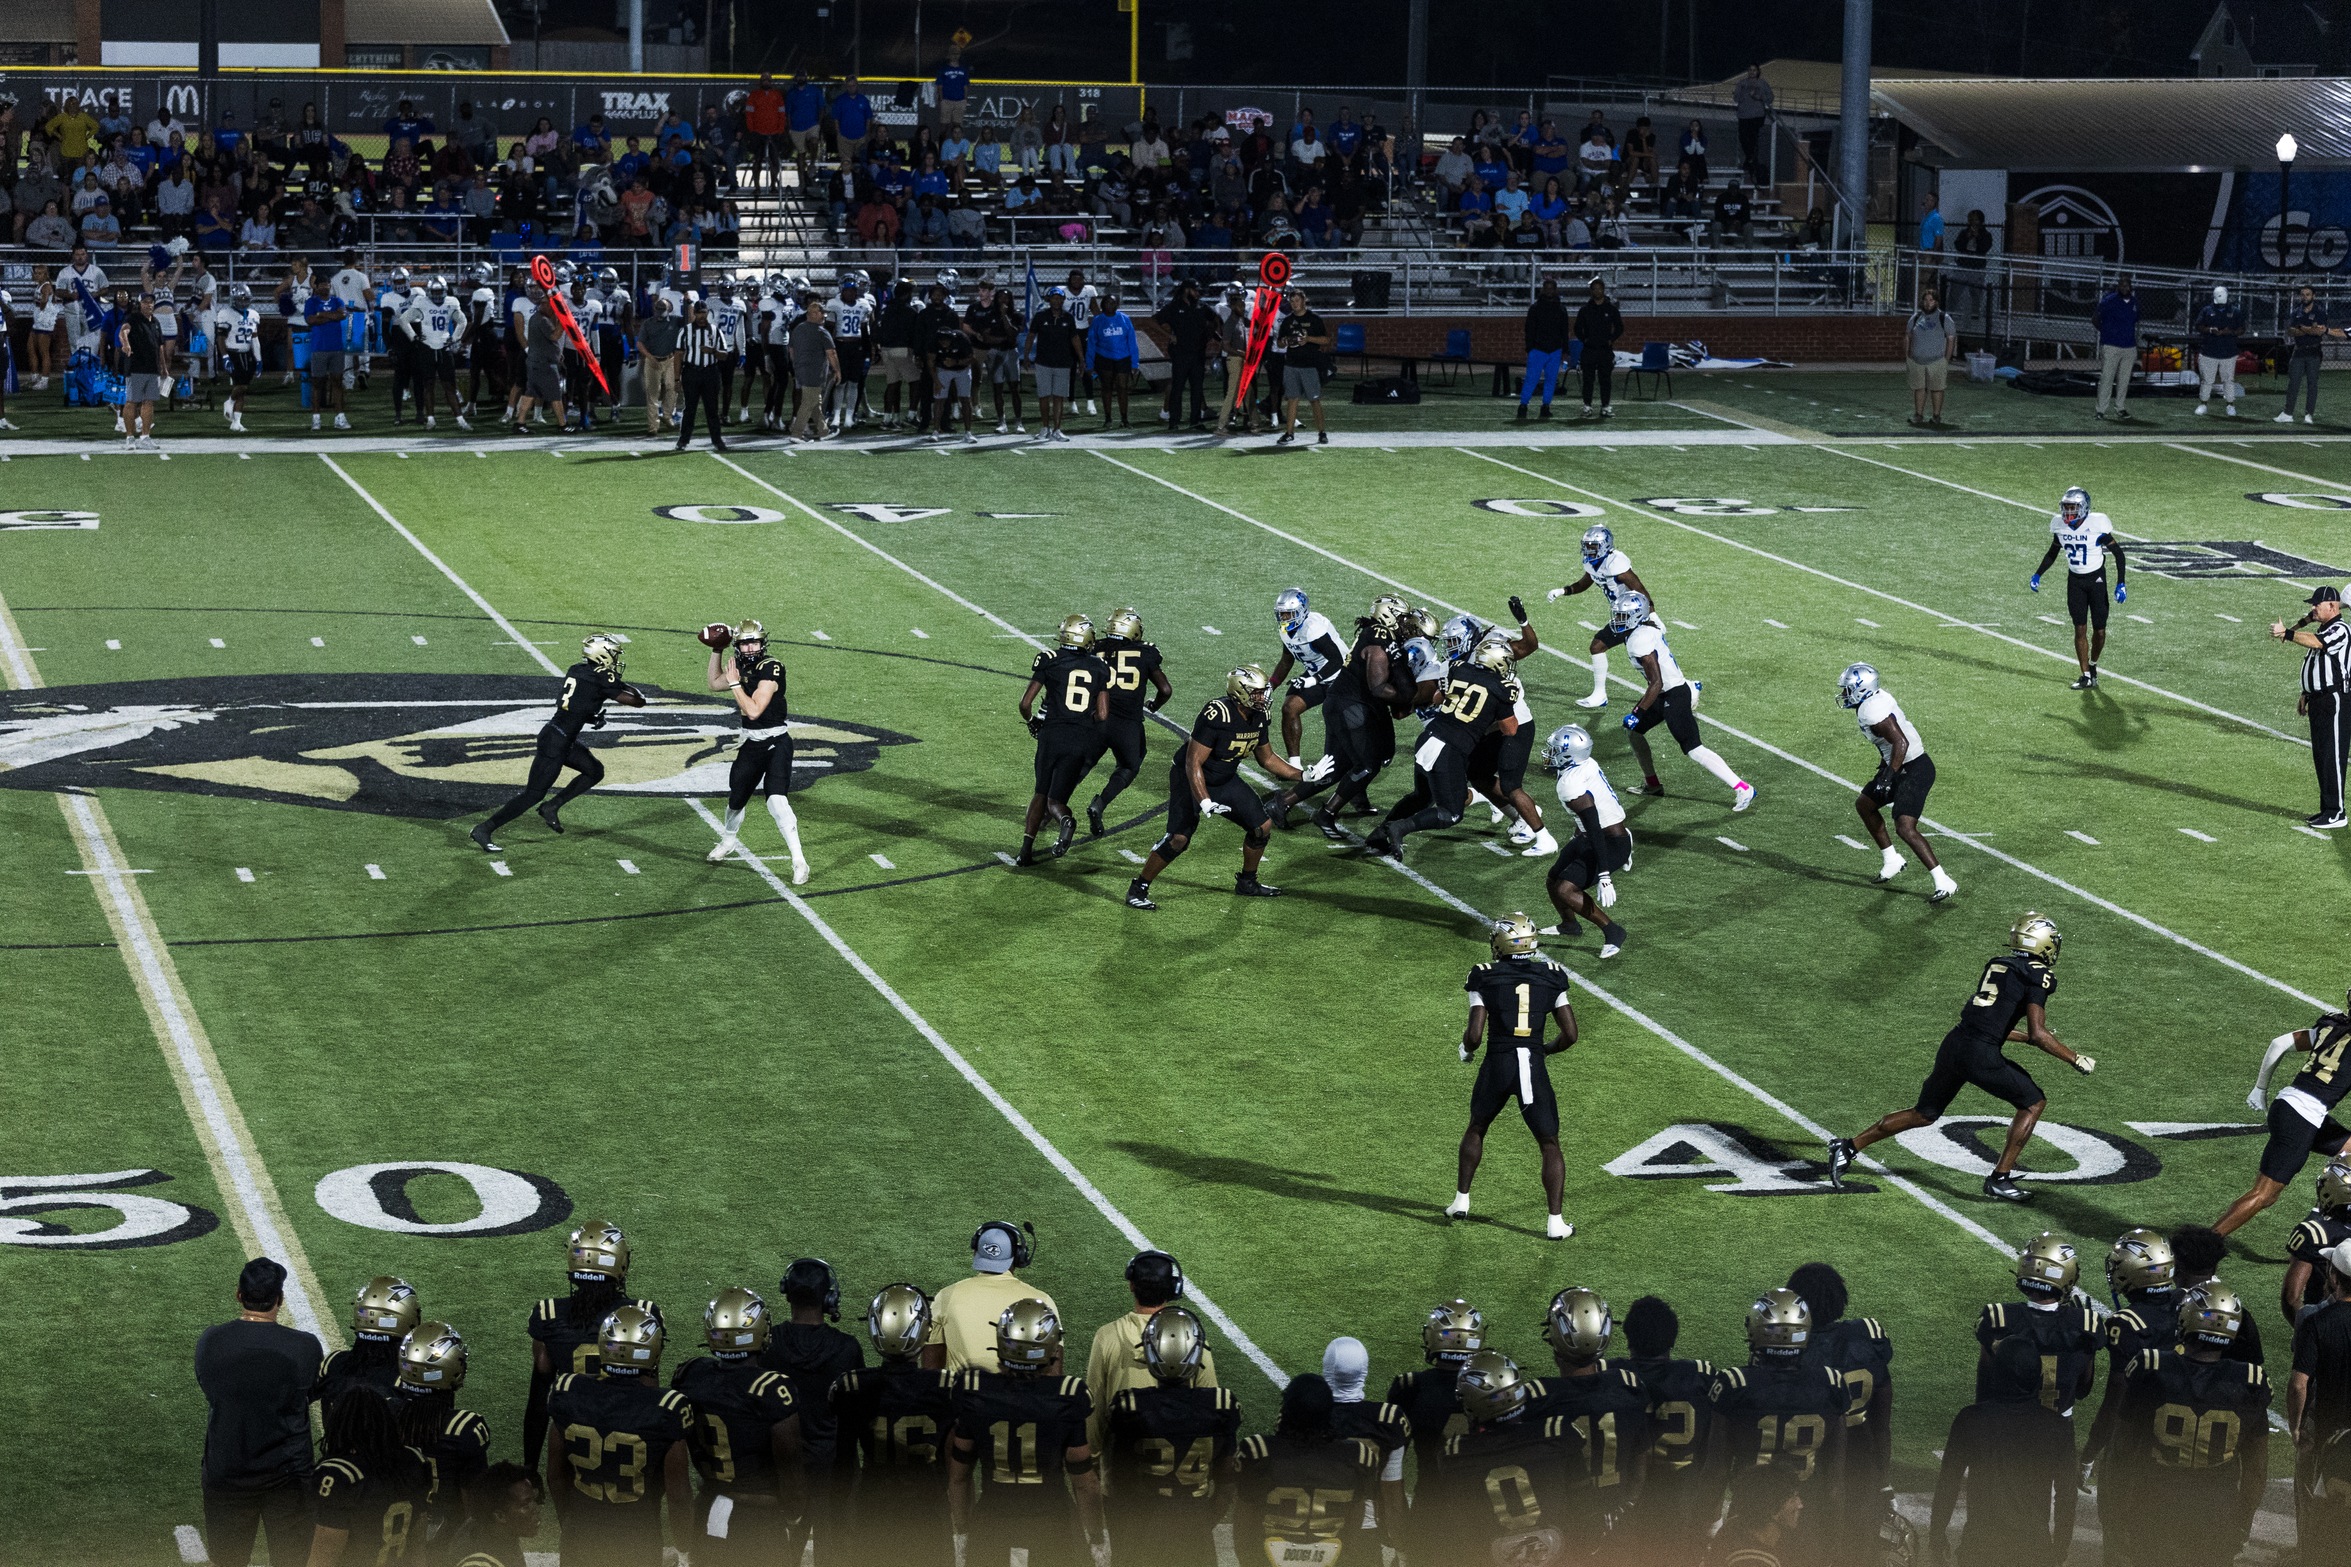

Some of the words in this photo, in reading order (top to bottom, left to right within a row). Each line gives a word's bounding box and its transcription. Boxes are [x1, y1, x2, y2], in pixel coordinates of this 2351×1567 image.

[45, 87, 132, 108] TRACE
[600, 92, 671, 113] TRAX
[2260, 210, 2350, 268] Go
[680, 244, 691, 272] 1
[1068, 301, 1085, 320] 40
[718, 314, 736, 335] 28
[842, 316, 860, 334] 30
[2064, 543, 2087, 566] 27
[1373, 627, 1388, 640] 73
[772, 664, 781, 677] 2
[1033, 655, 1042, 667] 6
[607, 672, 616, 683] 3
[1064, 669, 1093, 713] 6
[1440, 678, 1489, 724] 50
[1203, 706, 1219, 721] 79
[1972, 964, 2009, 1007] 5
[2041, 973, 2051, 989] 5
[1513, 983, 1533, 1037] 1
[573, 1271, 605, 1282] Riddell
[2021, 1278, 2052, 1292] Riddell
[358, 1332, 390, 1342] Riddell
[2198, 1333, 2230, 1345] Riddell
[715, 1350, 748, 1360] Riddell
[1766, 1348, 1800, 1356] Riddell
[606, 1364, 640, 1376] Riddell
[402, 1381, 433, 1394] Riddell
[777, 1385, 793, 1406] 9
[473, 1421, 490, 1447] 17
[2153, 1402, 2241, 1468] 90
[988, 1420, 1044, 1485] 11
[1756, 1413, 1826, 1482] 19
[564, 1422, 647, 1504] 23
[318, 1475, 335, 1498] 8
[1484, 1464, 1542, 1531] 0
